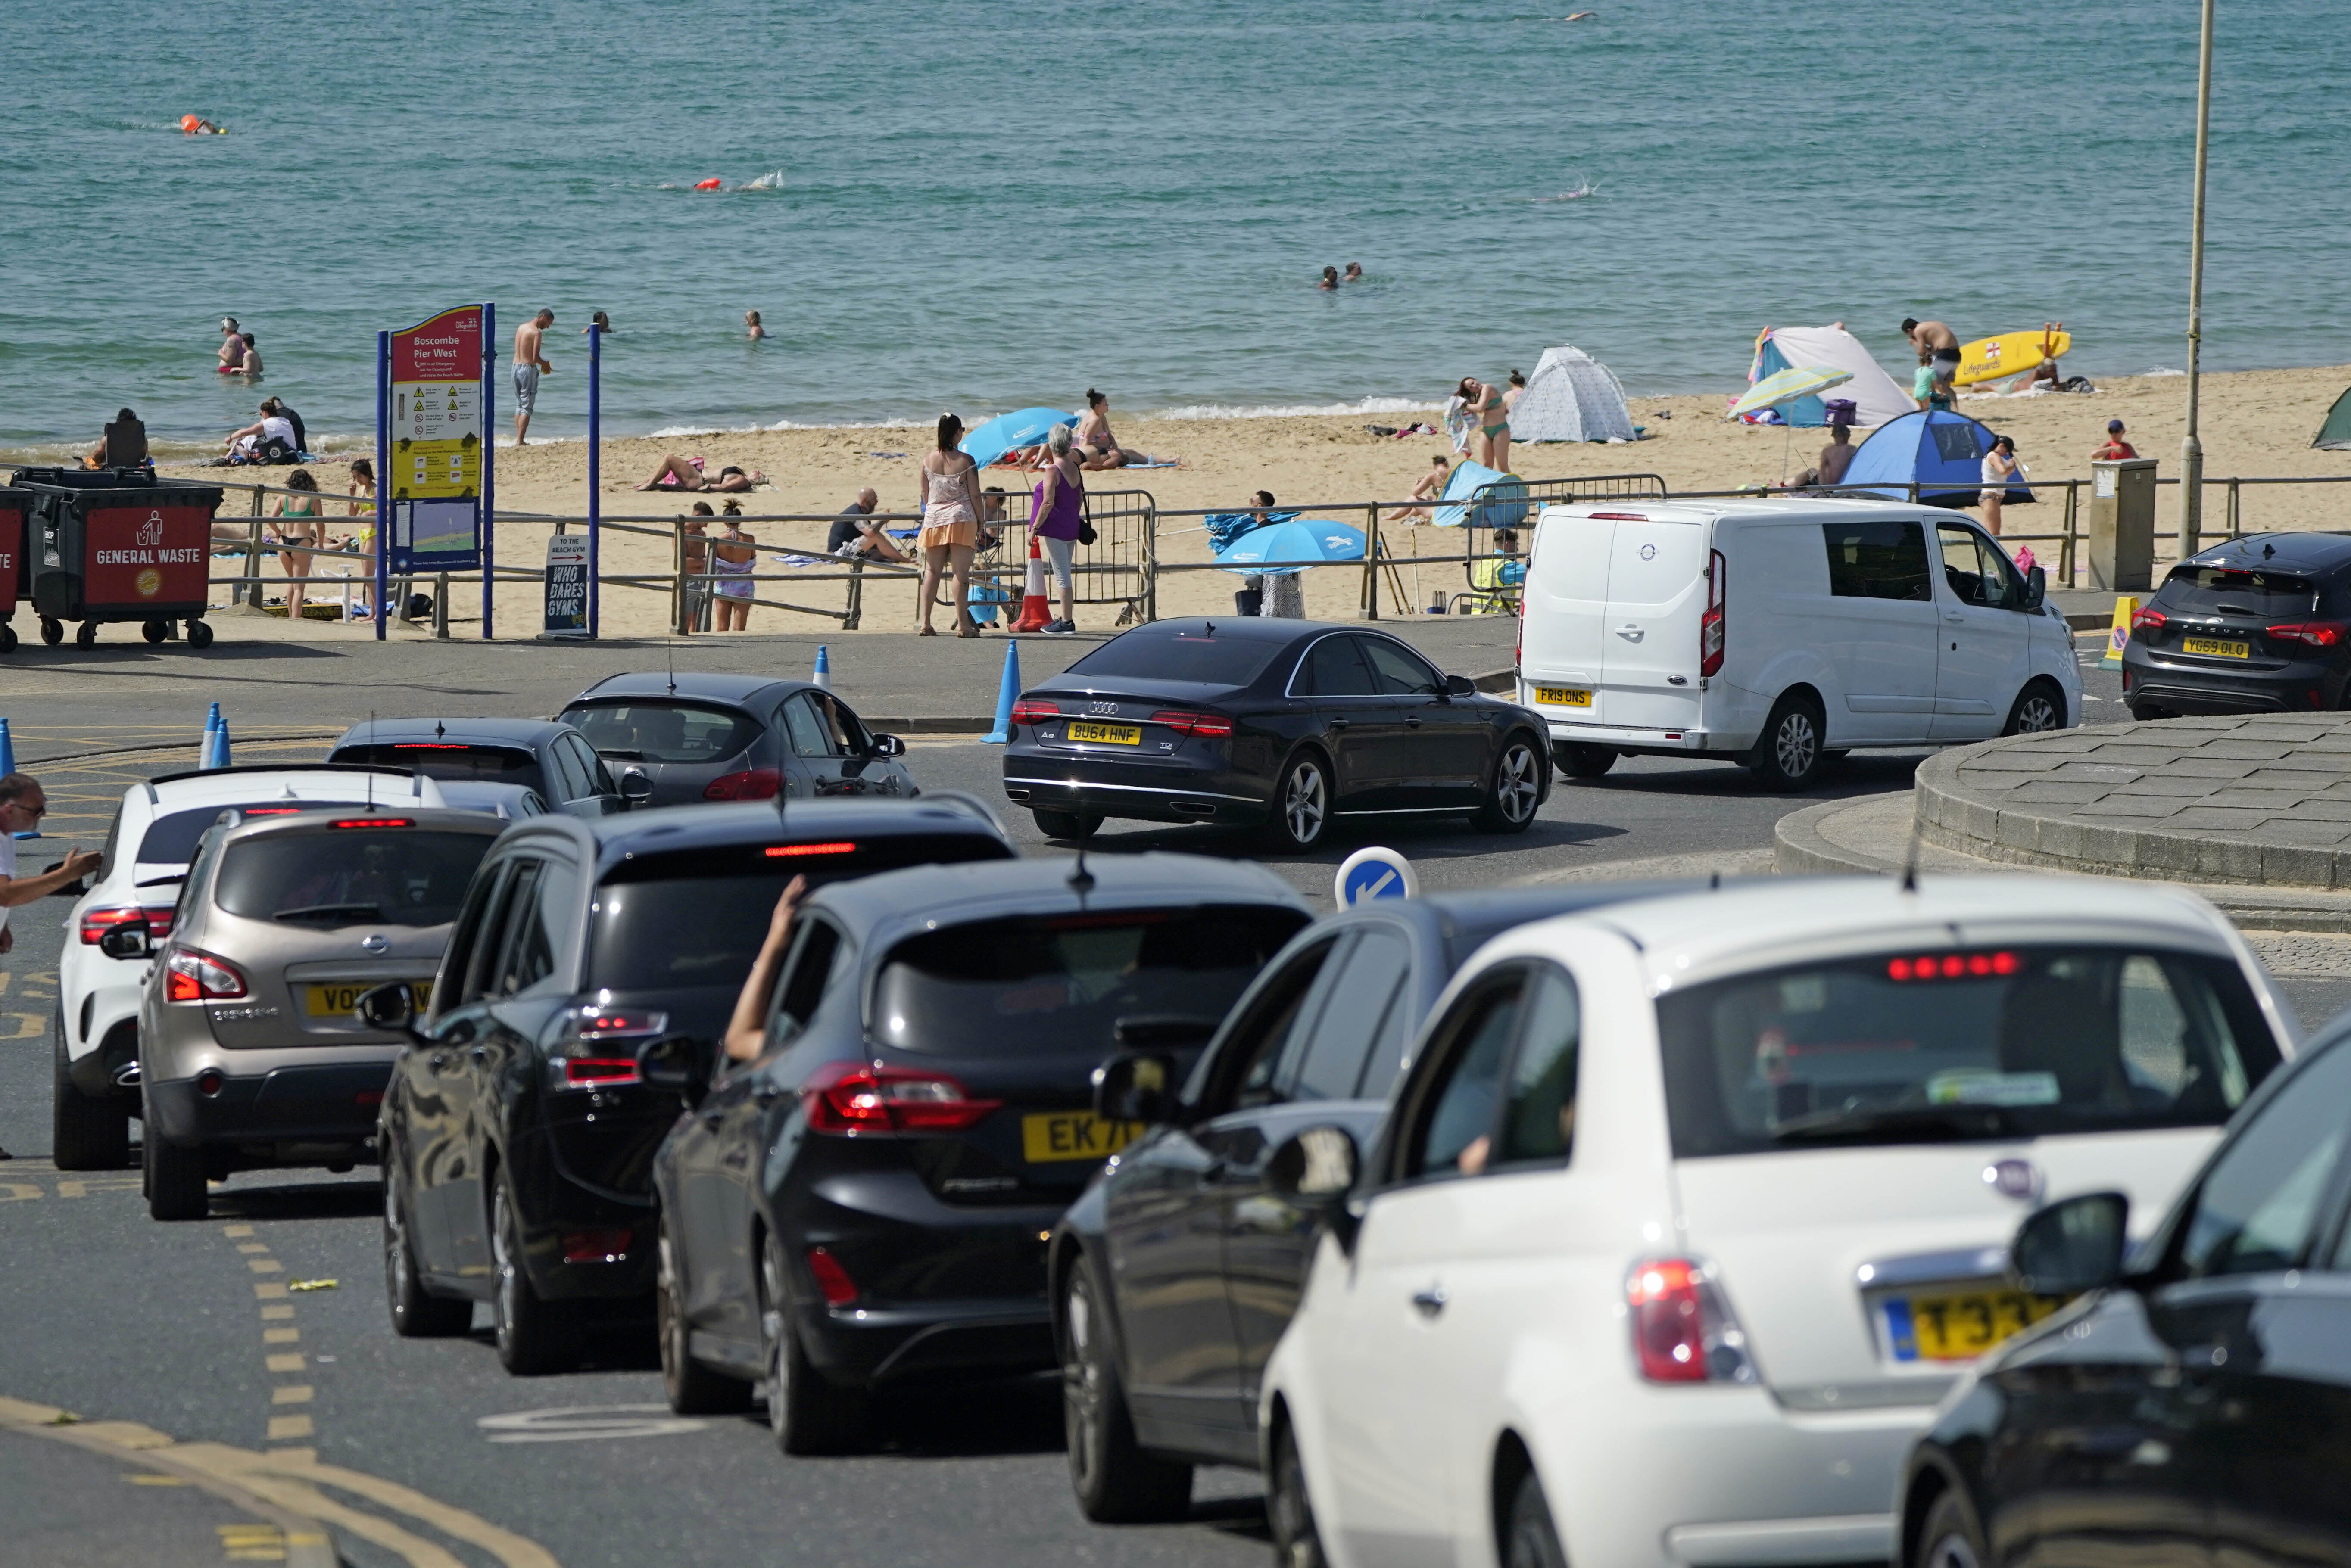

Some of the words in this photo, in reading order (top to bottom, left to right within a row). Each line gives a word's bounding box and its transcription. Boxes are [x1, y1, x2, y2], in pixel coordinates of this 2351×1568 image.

[414, 336, 459, 345] Boscombe
[414, 349, 431, 358] Pier
[433, 348, 457, 357] West
[1964, 358, 2001, 375] Lifeguards
[97, 550, 154, 564] GENERAL
[158, 548, 200, 563] WASTE
[553, 566, 578, 582] WHO
[549, 582, 585, 598] DARES
[547, 599, 579, 616] GYMS
[2183, 625, 2245, 634] FOCUS
[2189, 639, 2218, 652] YG69
[1541, 688, 1563, 702] FR19
[1566, 690, 1585, 703] ONS
[1074, 725, 1106, 740] BU64
[1110, 728, 1136, 741] HNF
